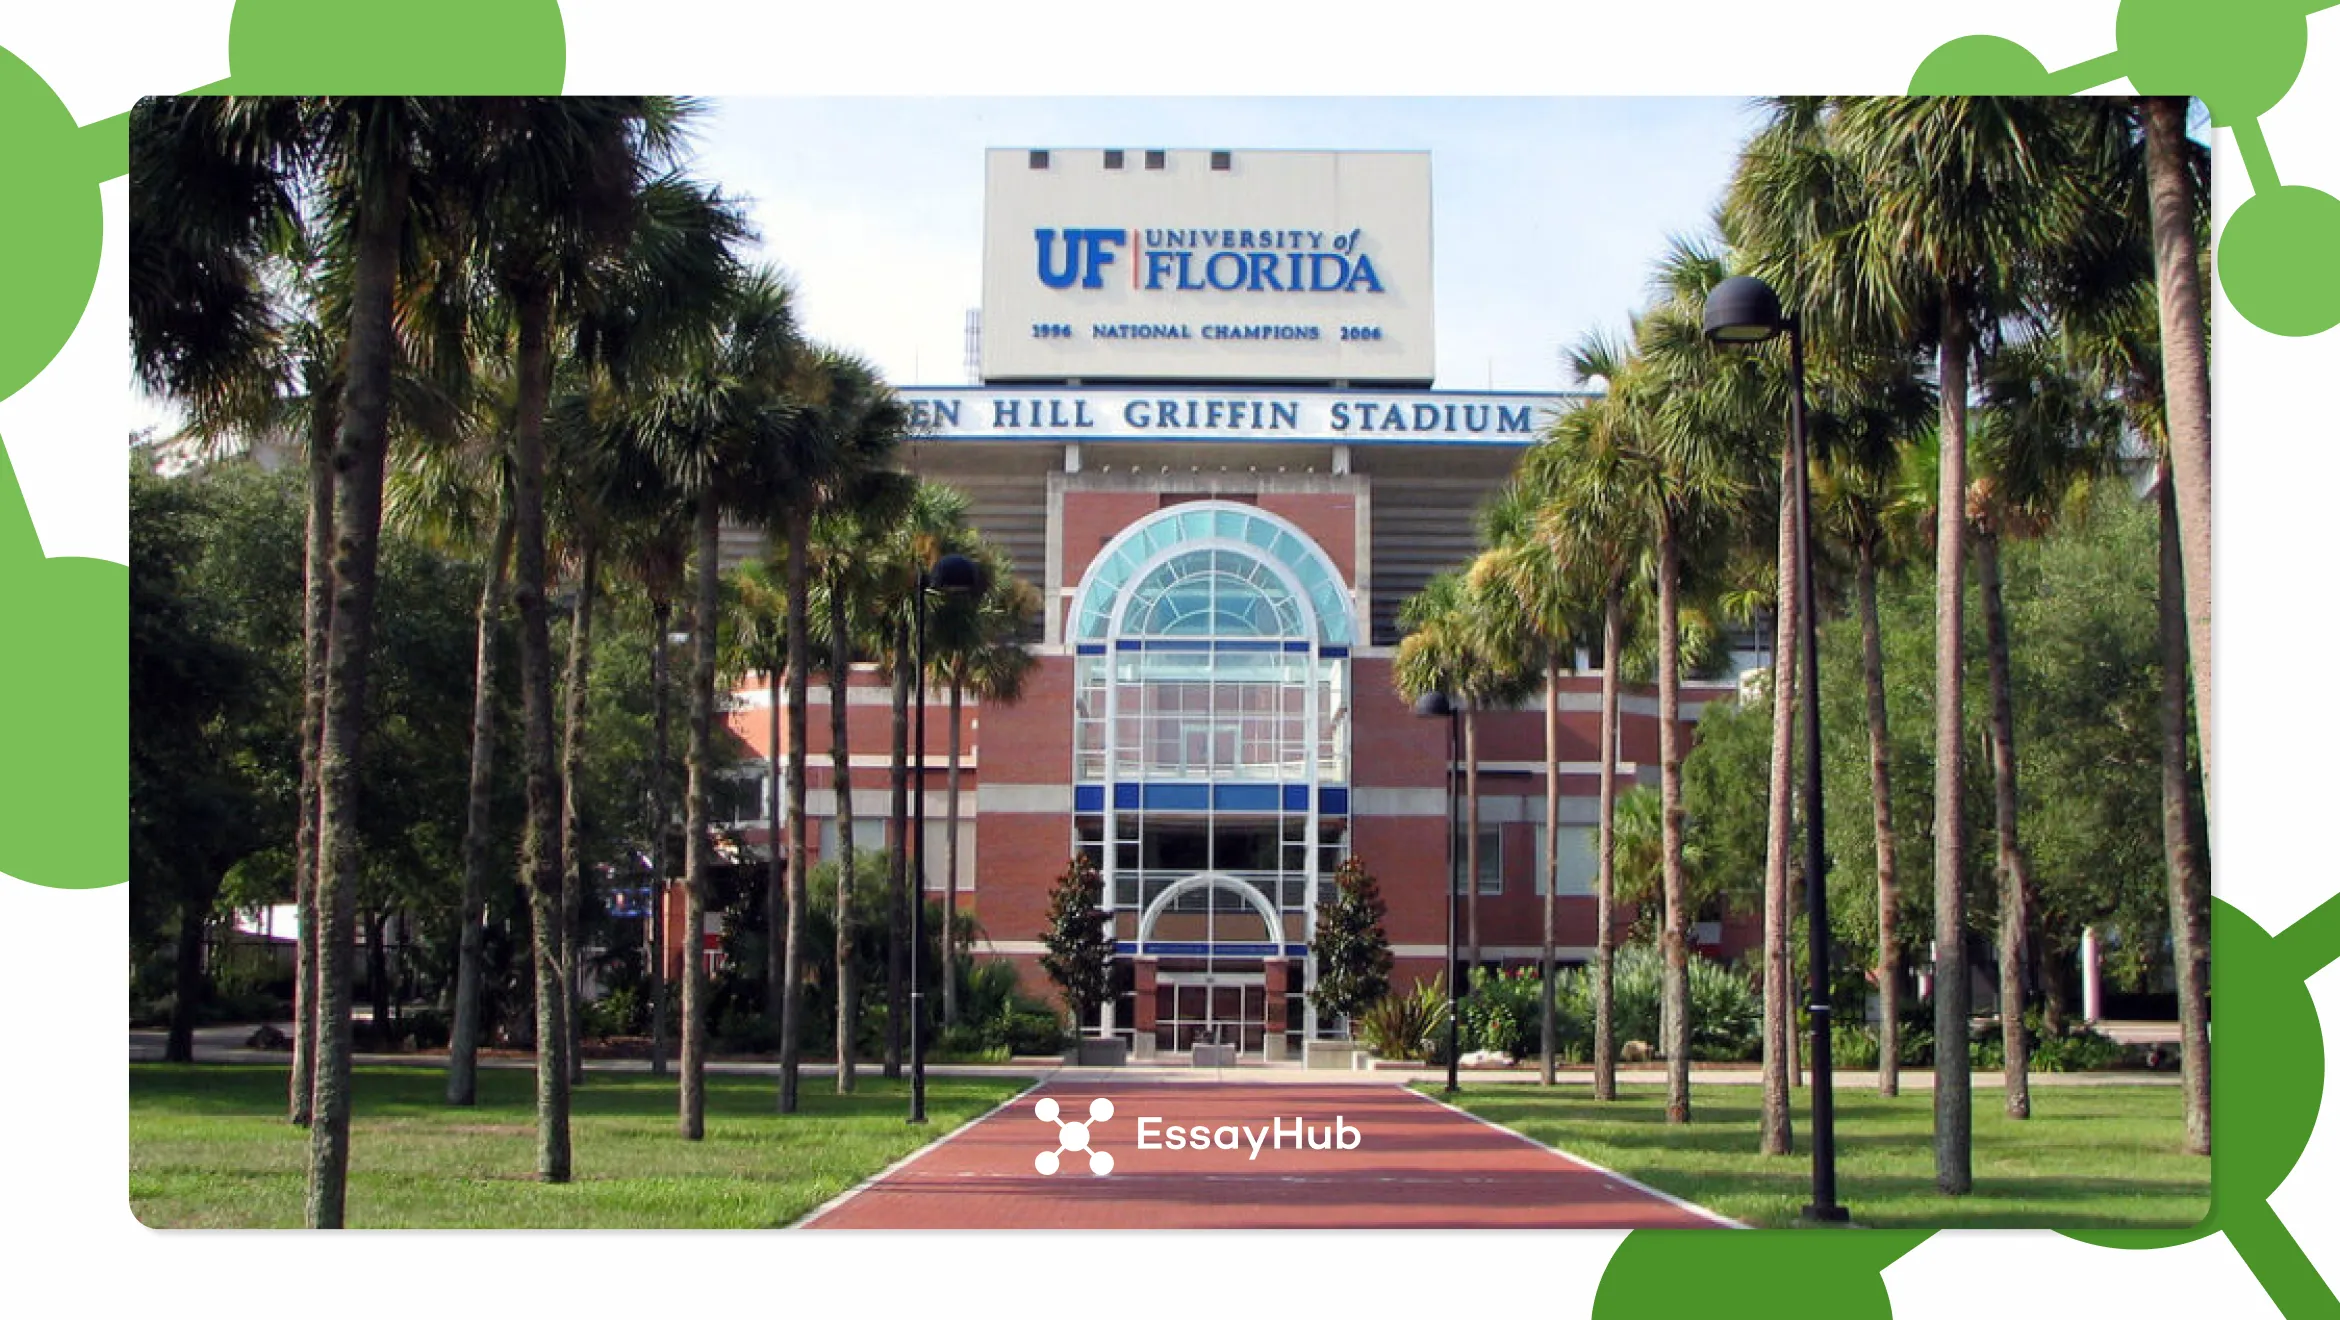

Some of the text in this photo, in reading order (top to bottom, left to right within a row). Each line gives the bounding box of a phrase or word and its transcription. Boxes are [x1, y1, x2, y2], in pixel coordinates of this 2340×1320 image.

[1034, 229, 1126, 288] UF
[1145, 228, 1361, 255] UNIVERSITY of
[1145, 251, 1385, 292] FLORIDA
[1092, 324, 1191, 339] NATIONAL
[1201, 325, 1320, 340] CHAMPIONS
[1340, 326, 1382, 341] 2006
[902, 399, 1531, 433] EN HILL GRIFFIN STADIUM
